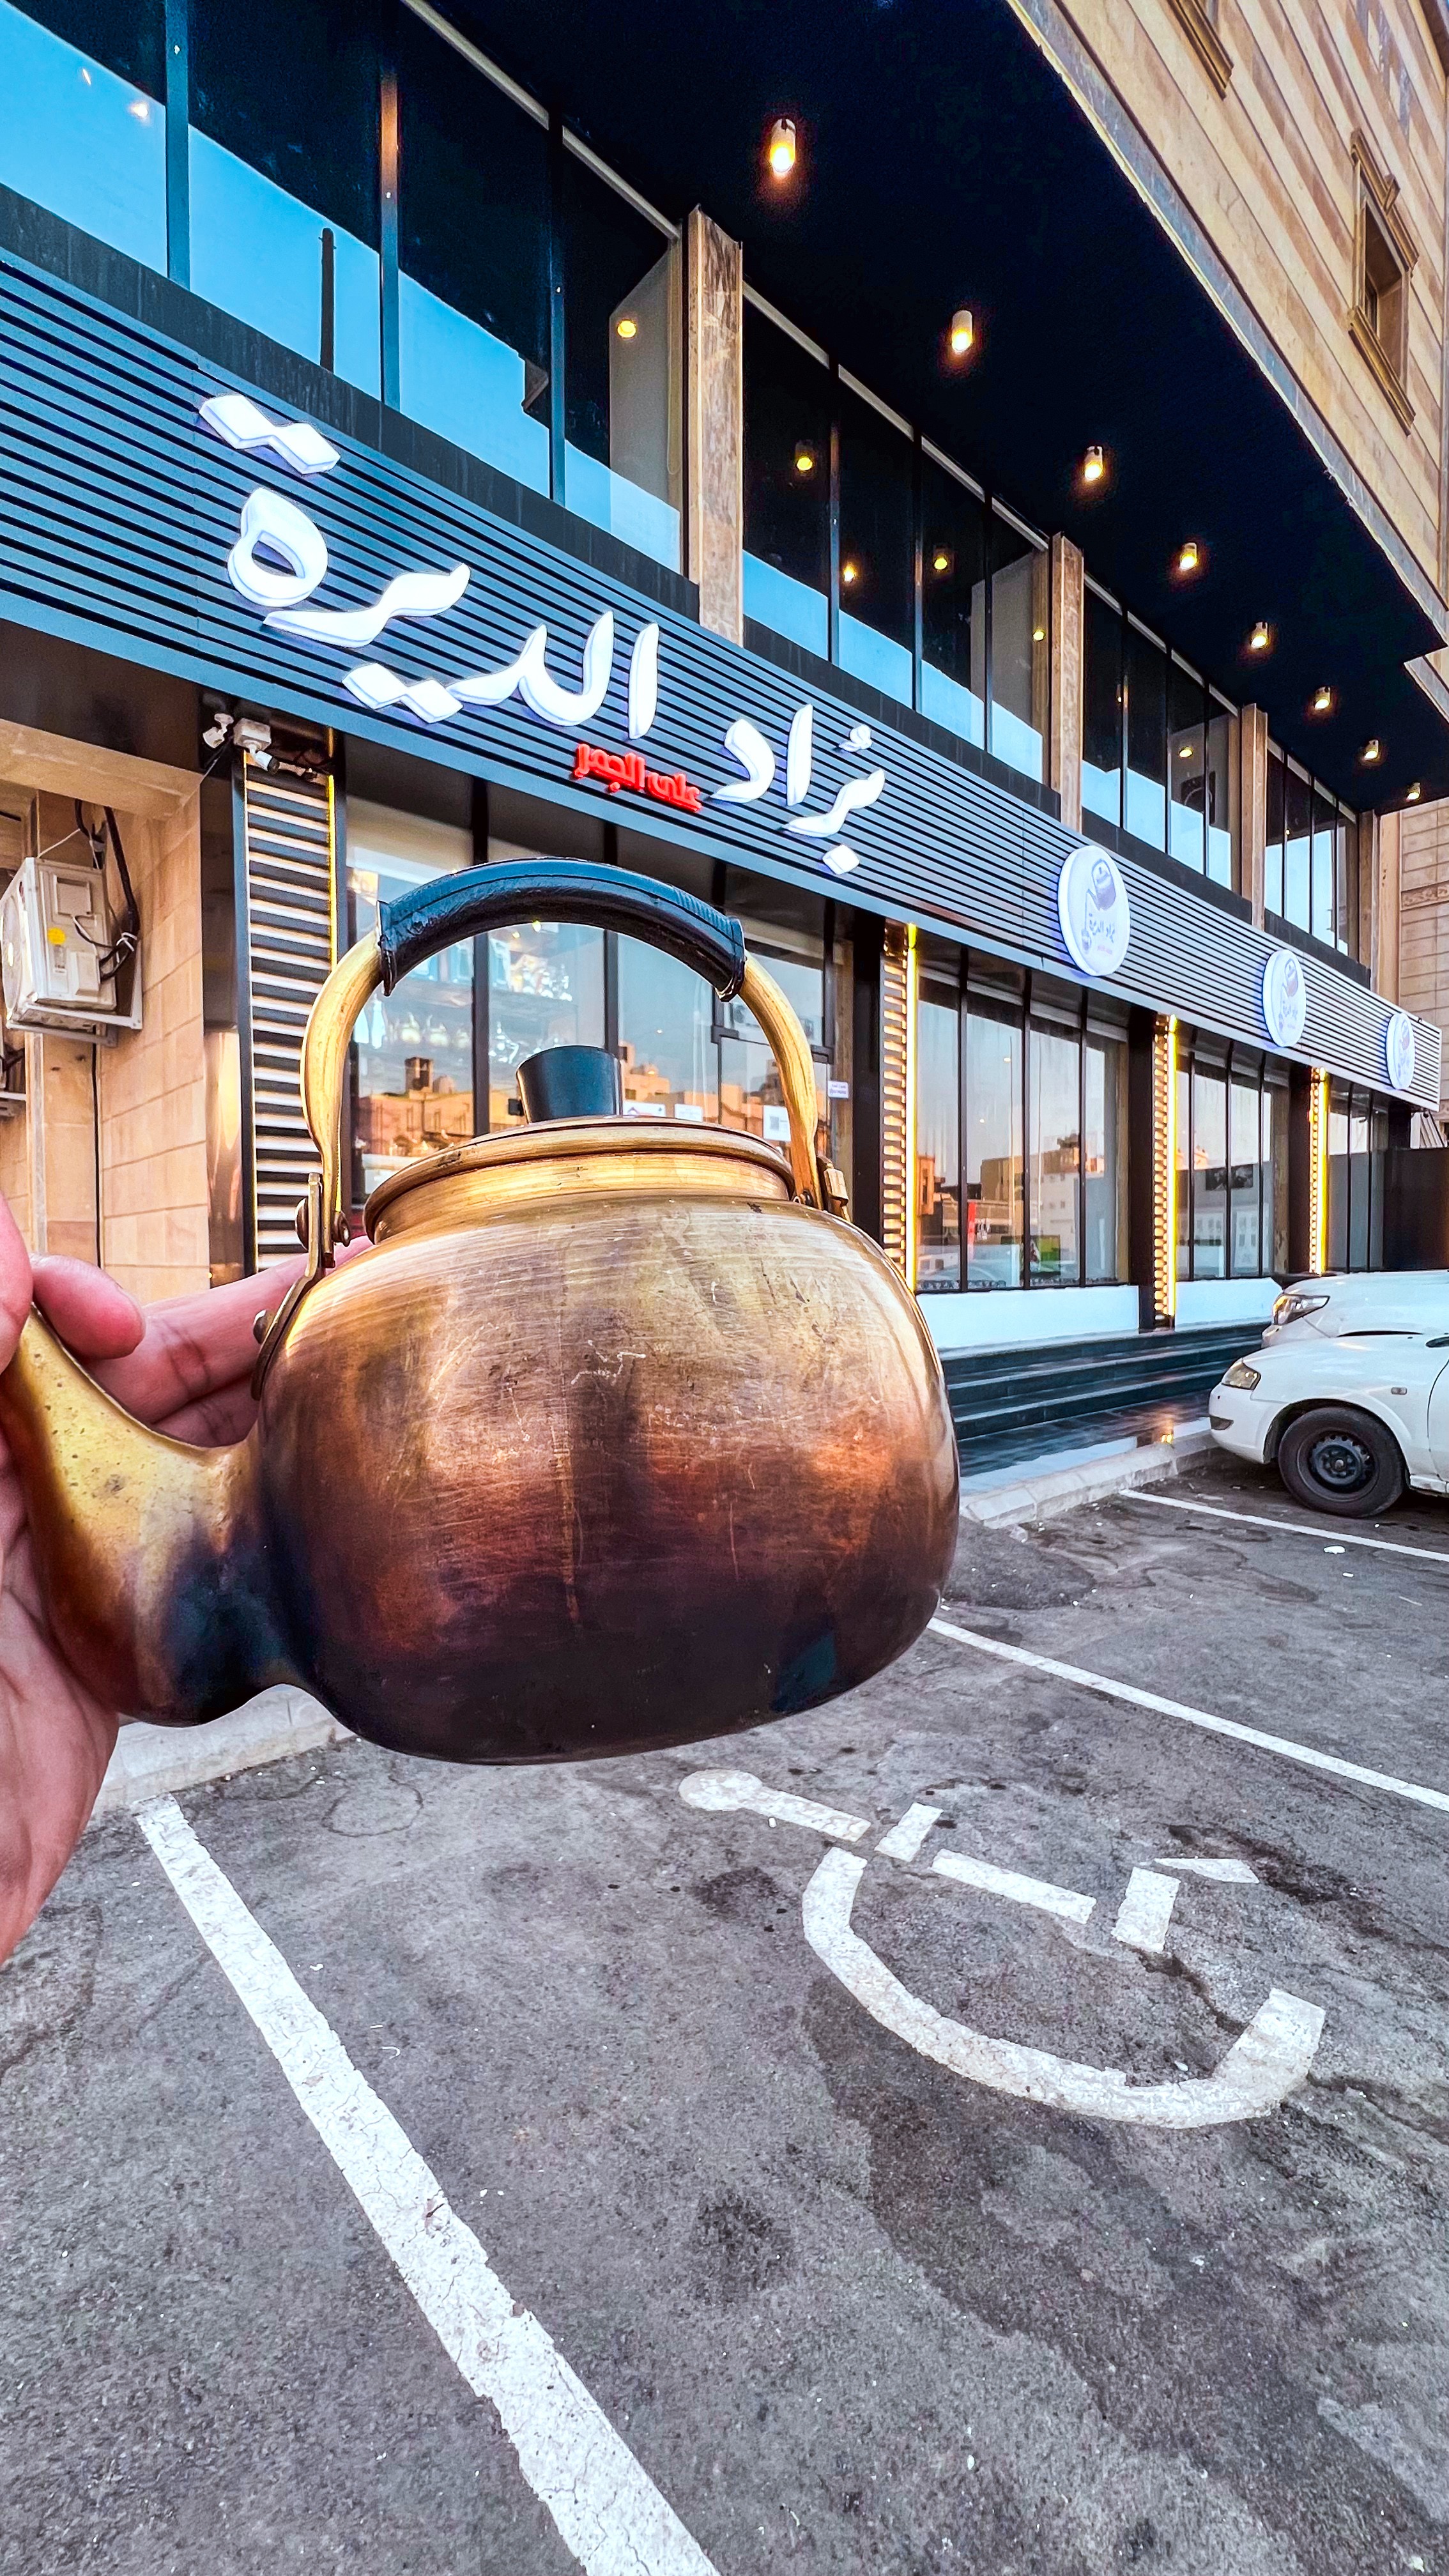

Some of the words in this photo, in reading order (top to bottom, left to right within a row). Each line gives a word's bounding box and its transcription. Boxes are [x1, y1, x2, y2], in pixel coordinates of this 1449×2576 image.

[198, 394, 660, 740] الديرة
[574, 742, 645, 793] الجمر
[647, 771, 702, 813] على
